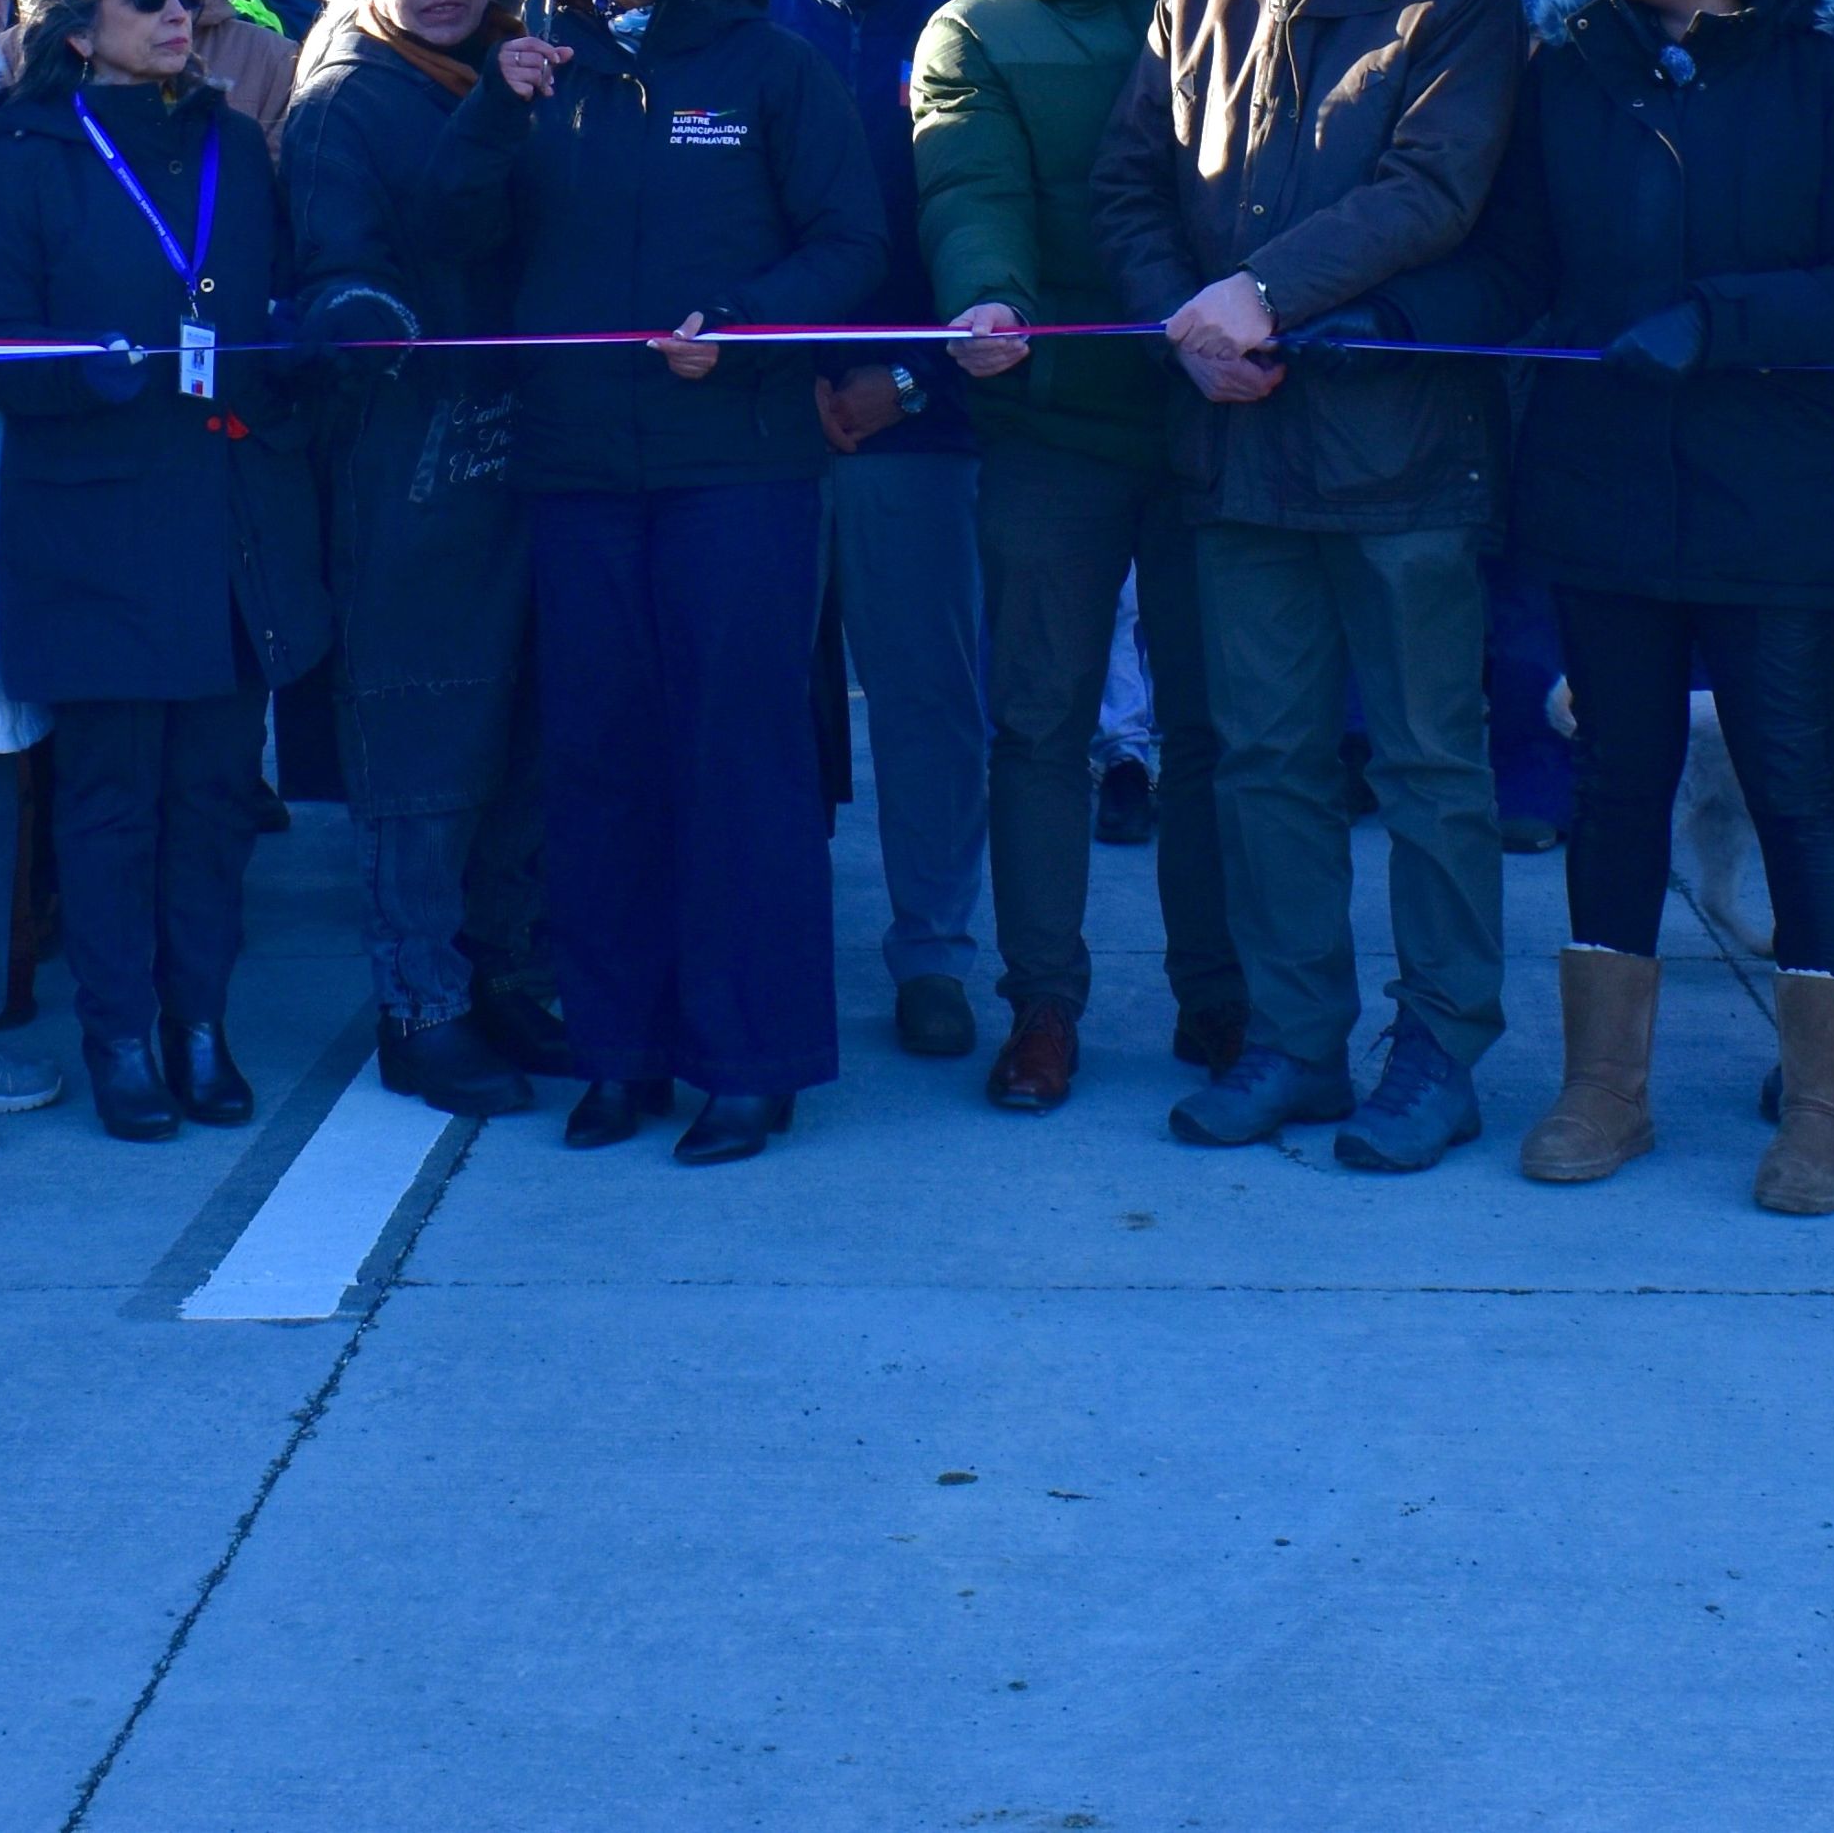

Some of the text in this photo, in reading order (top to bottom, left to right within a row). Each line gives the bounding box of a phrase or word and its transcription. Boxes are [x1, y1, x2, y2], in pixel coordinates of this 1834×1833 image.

[672, 116, 710, 125] ILUSTRE
[671, 125, 748, 135] MUNICIPALIDAD
[670, 136, 741, 146] DE PRIMAVERA
